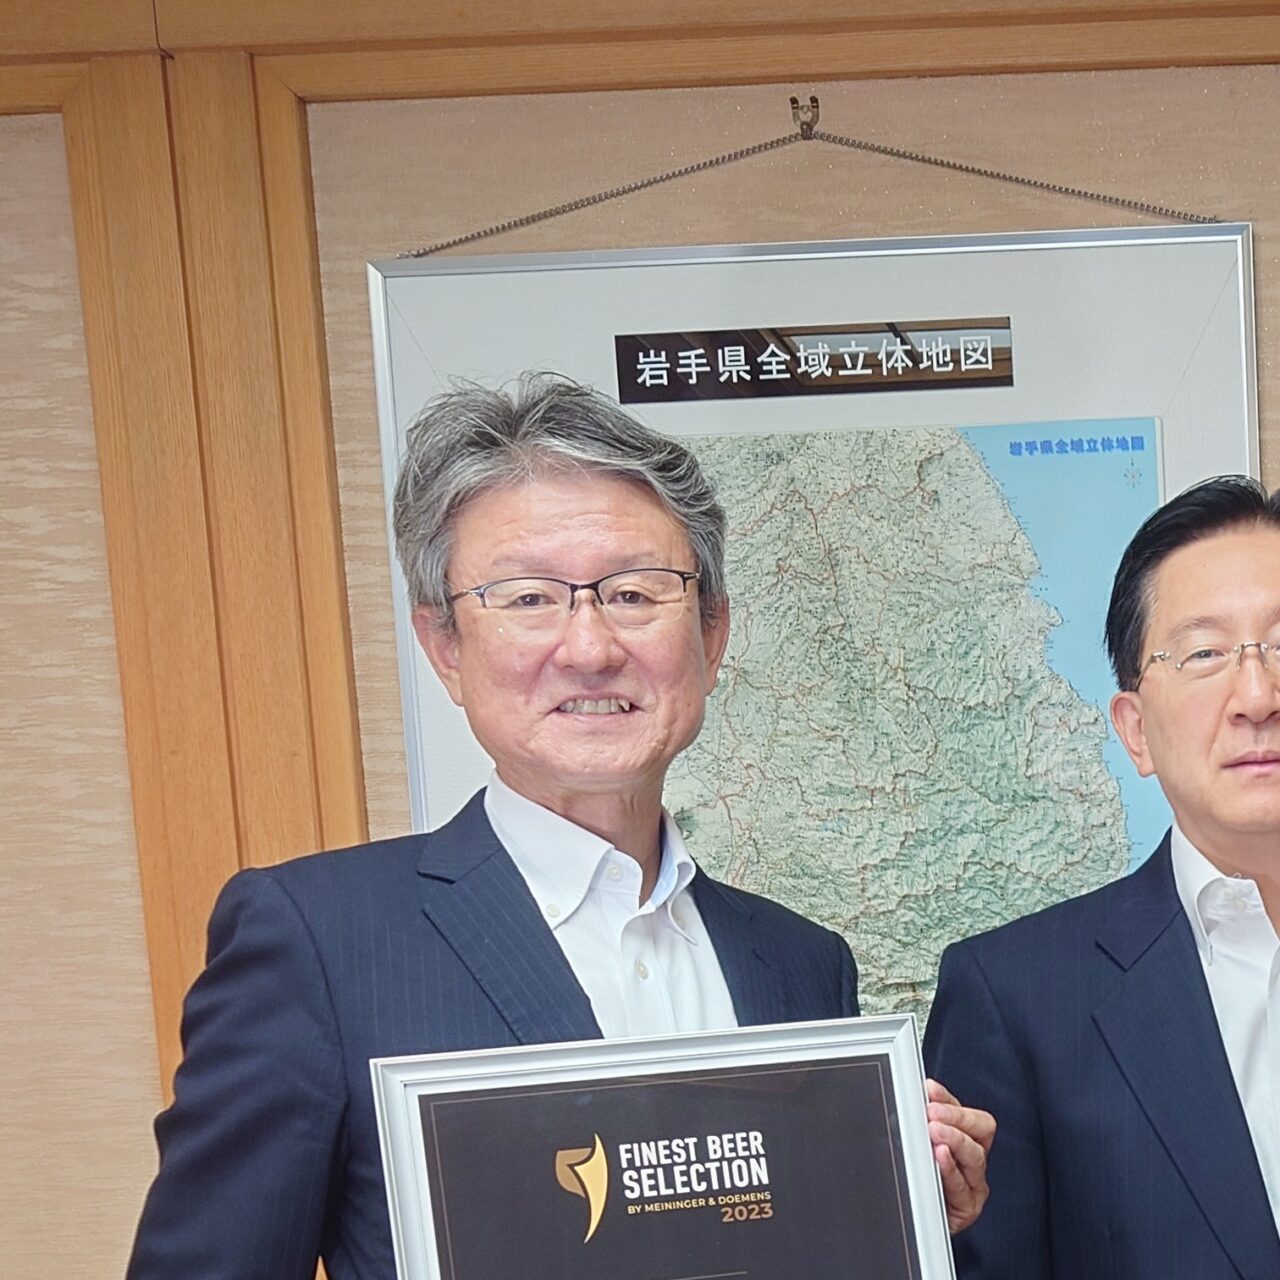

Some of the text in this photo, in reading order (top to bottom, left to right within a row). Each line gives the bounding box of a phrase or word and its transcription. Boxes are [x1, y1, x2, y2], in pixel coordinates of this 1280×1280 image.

[636, 335, 993, 388] 岩手県全域立体地図
[1008, 435, 1145, 456] 岩手県全域立体地図
[619, 1131, 765, 1168] FINEST BEER
[622, 1157, 770, 1199] SELECTION
[627, 1191, 772, 1215] BY MEININGER & DOEMENS
[720, 1203, 774, 1223] 2023
